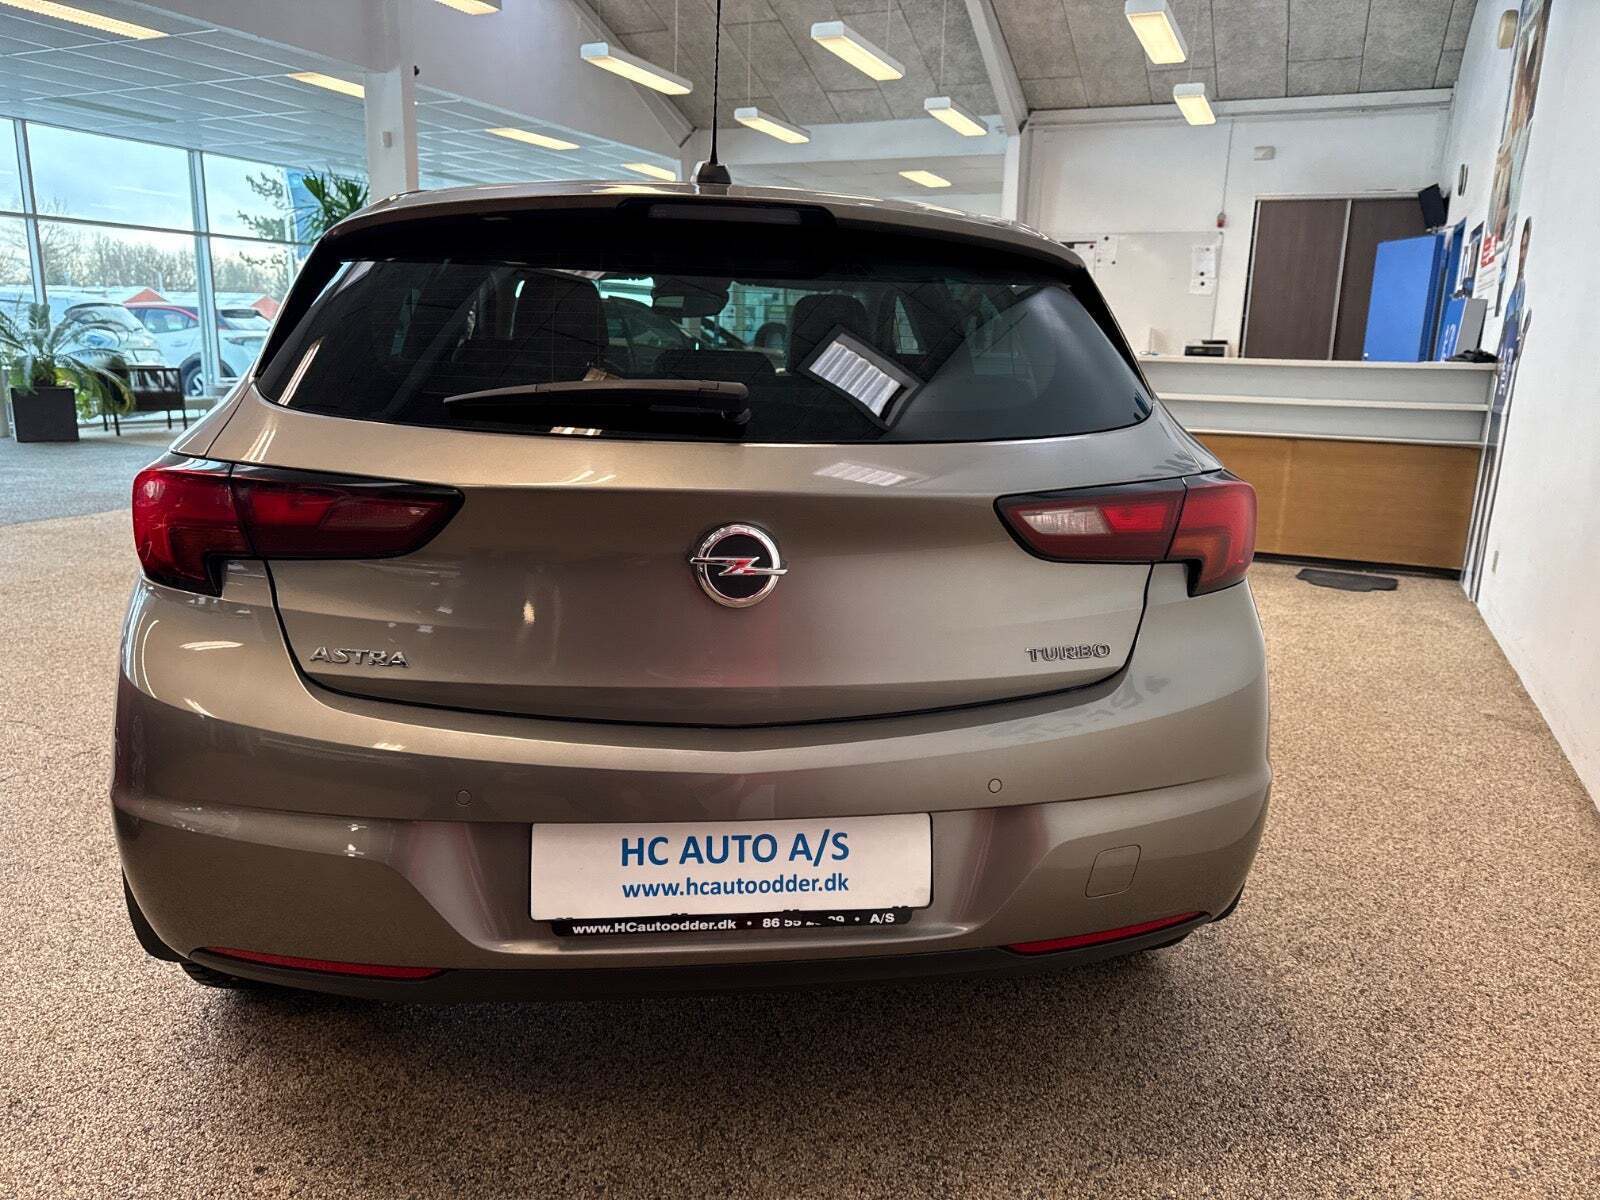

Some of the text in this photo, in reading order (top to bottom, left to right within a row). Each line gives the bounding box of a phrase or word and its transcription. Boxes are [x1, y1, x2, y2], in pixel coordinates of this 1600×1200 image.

[309, 647, 409, 668] ASTRA
[1024, 643, 1111, 662] TURBO
[621, 828, 849, 867] HC AUTO A/S
[622, 873, 849, 898] www.hcautoodder.dk
[573, 919, 737, 934] www.HCautoodder.dk
[762, 918, 781, 928] 86
[869, 912, 896, 925] A/S
